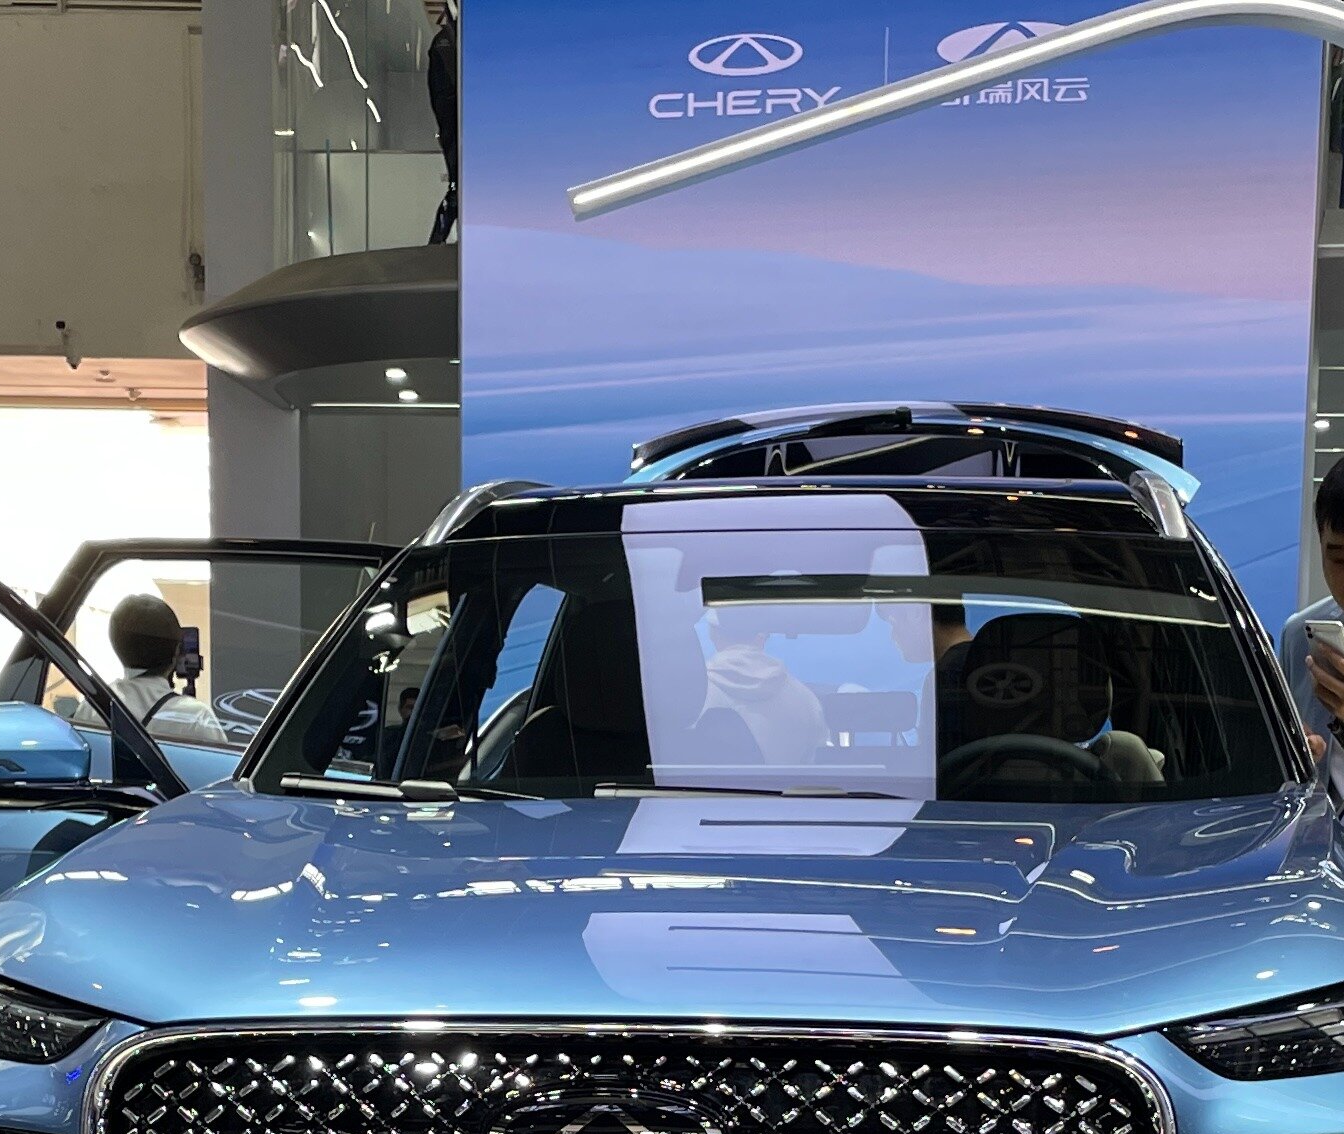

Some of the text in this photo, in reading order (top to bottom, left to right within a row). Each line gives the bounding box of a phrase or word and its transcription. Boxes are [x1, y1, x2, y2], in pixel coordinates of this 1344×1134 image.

[648, 86, 843, 119] CHERY
[940, 77, 1091, 107] 瑞风云
